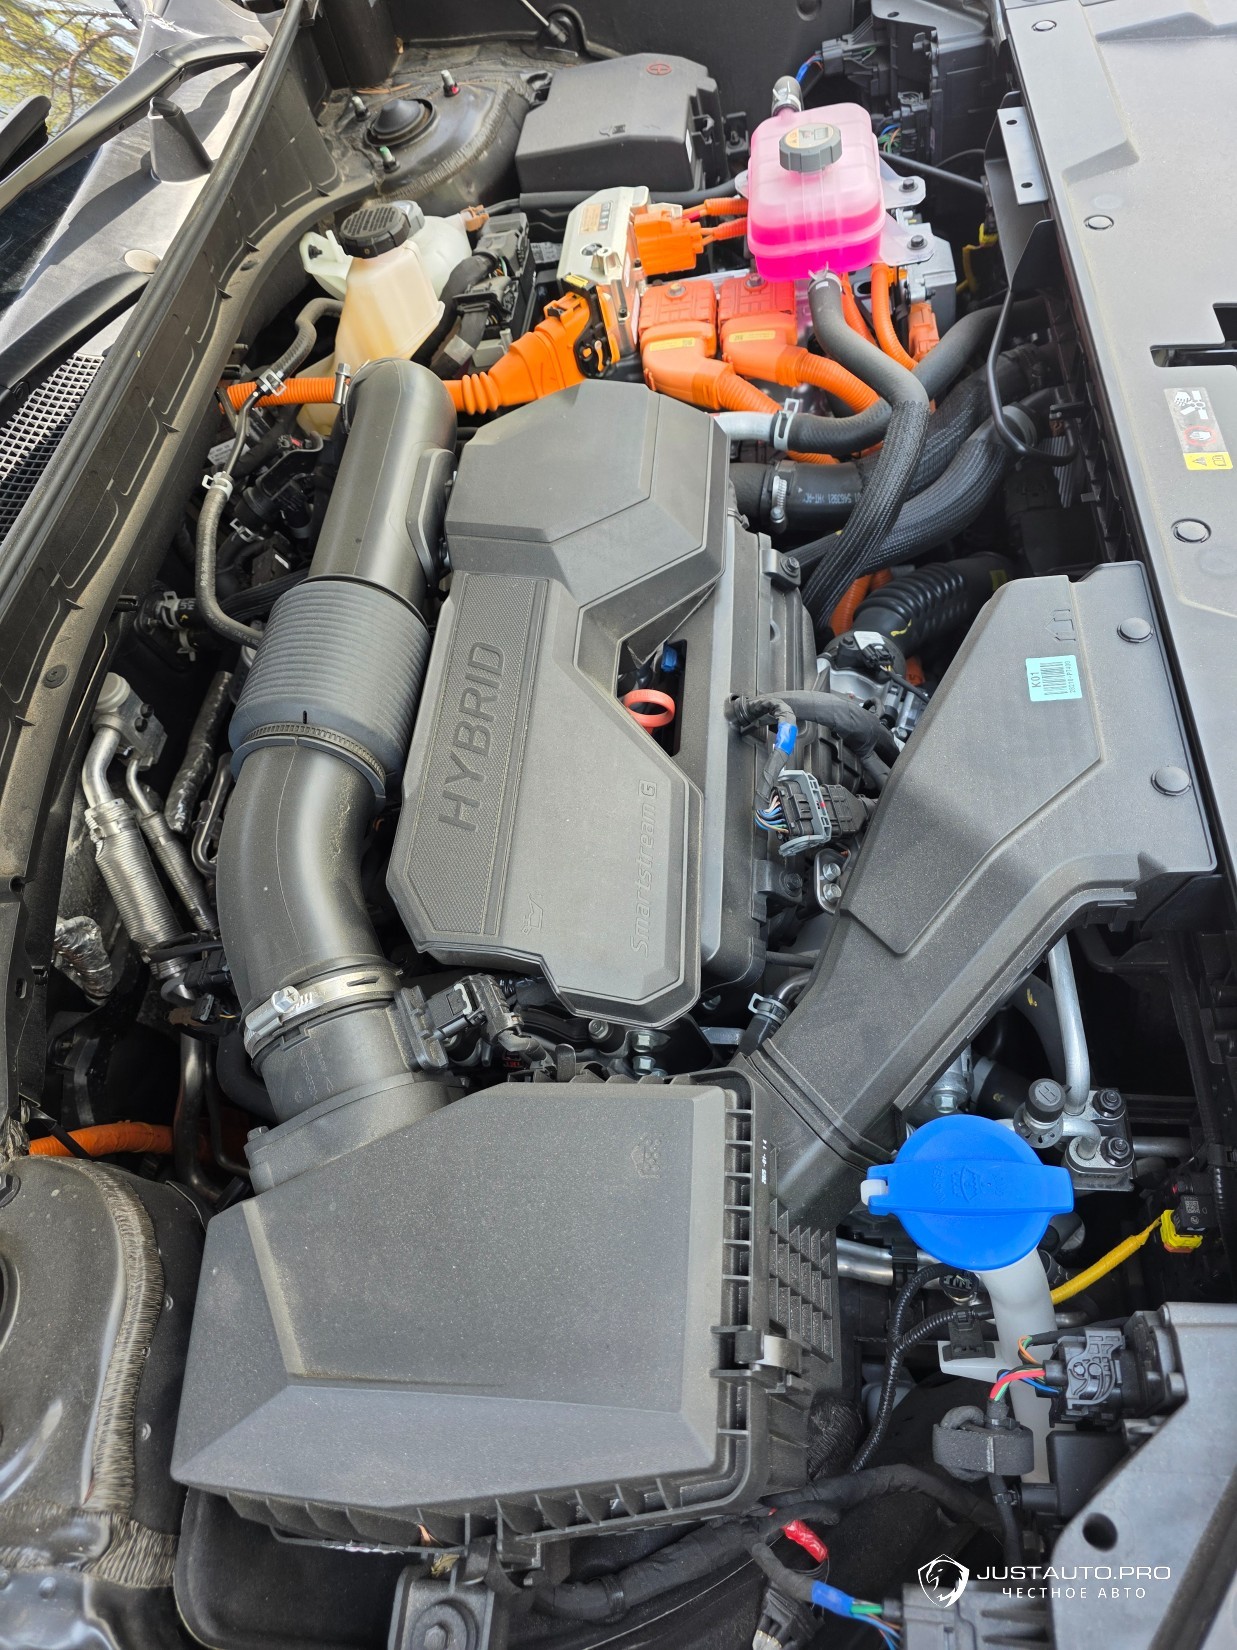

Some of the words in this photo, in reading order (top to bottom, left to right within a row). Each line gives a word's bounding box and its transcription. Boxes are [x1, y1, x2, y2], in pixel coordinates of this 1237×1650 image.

[438, 641, 505, 832] HYBRID
[1030, 671, 1041, 688] K01
[629, 803, 655, 958] Smartstream
